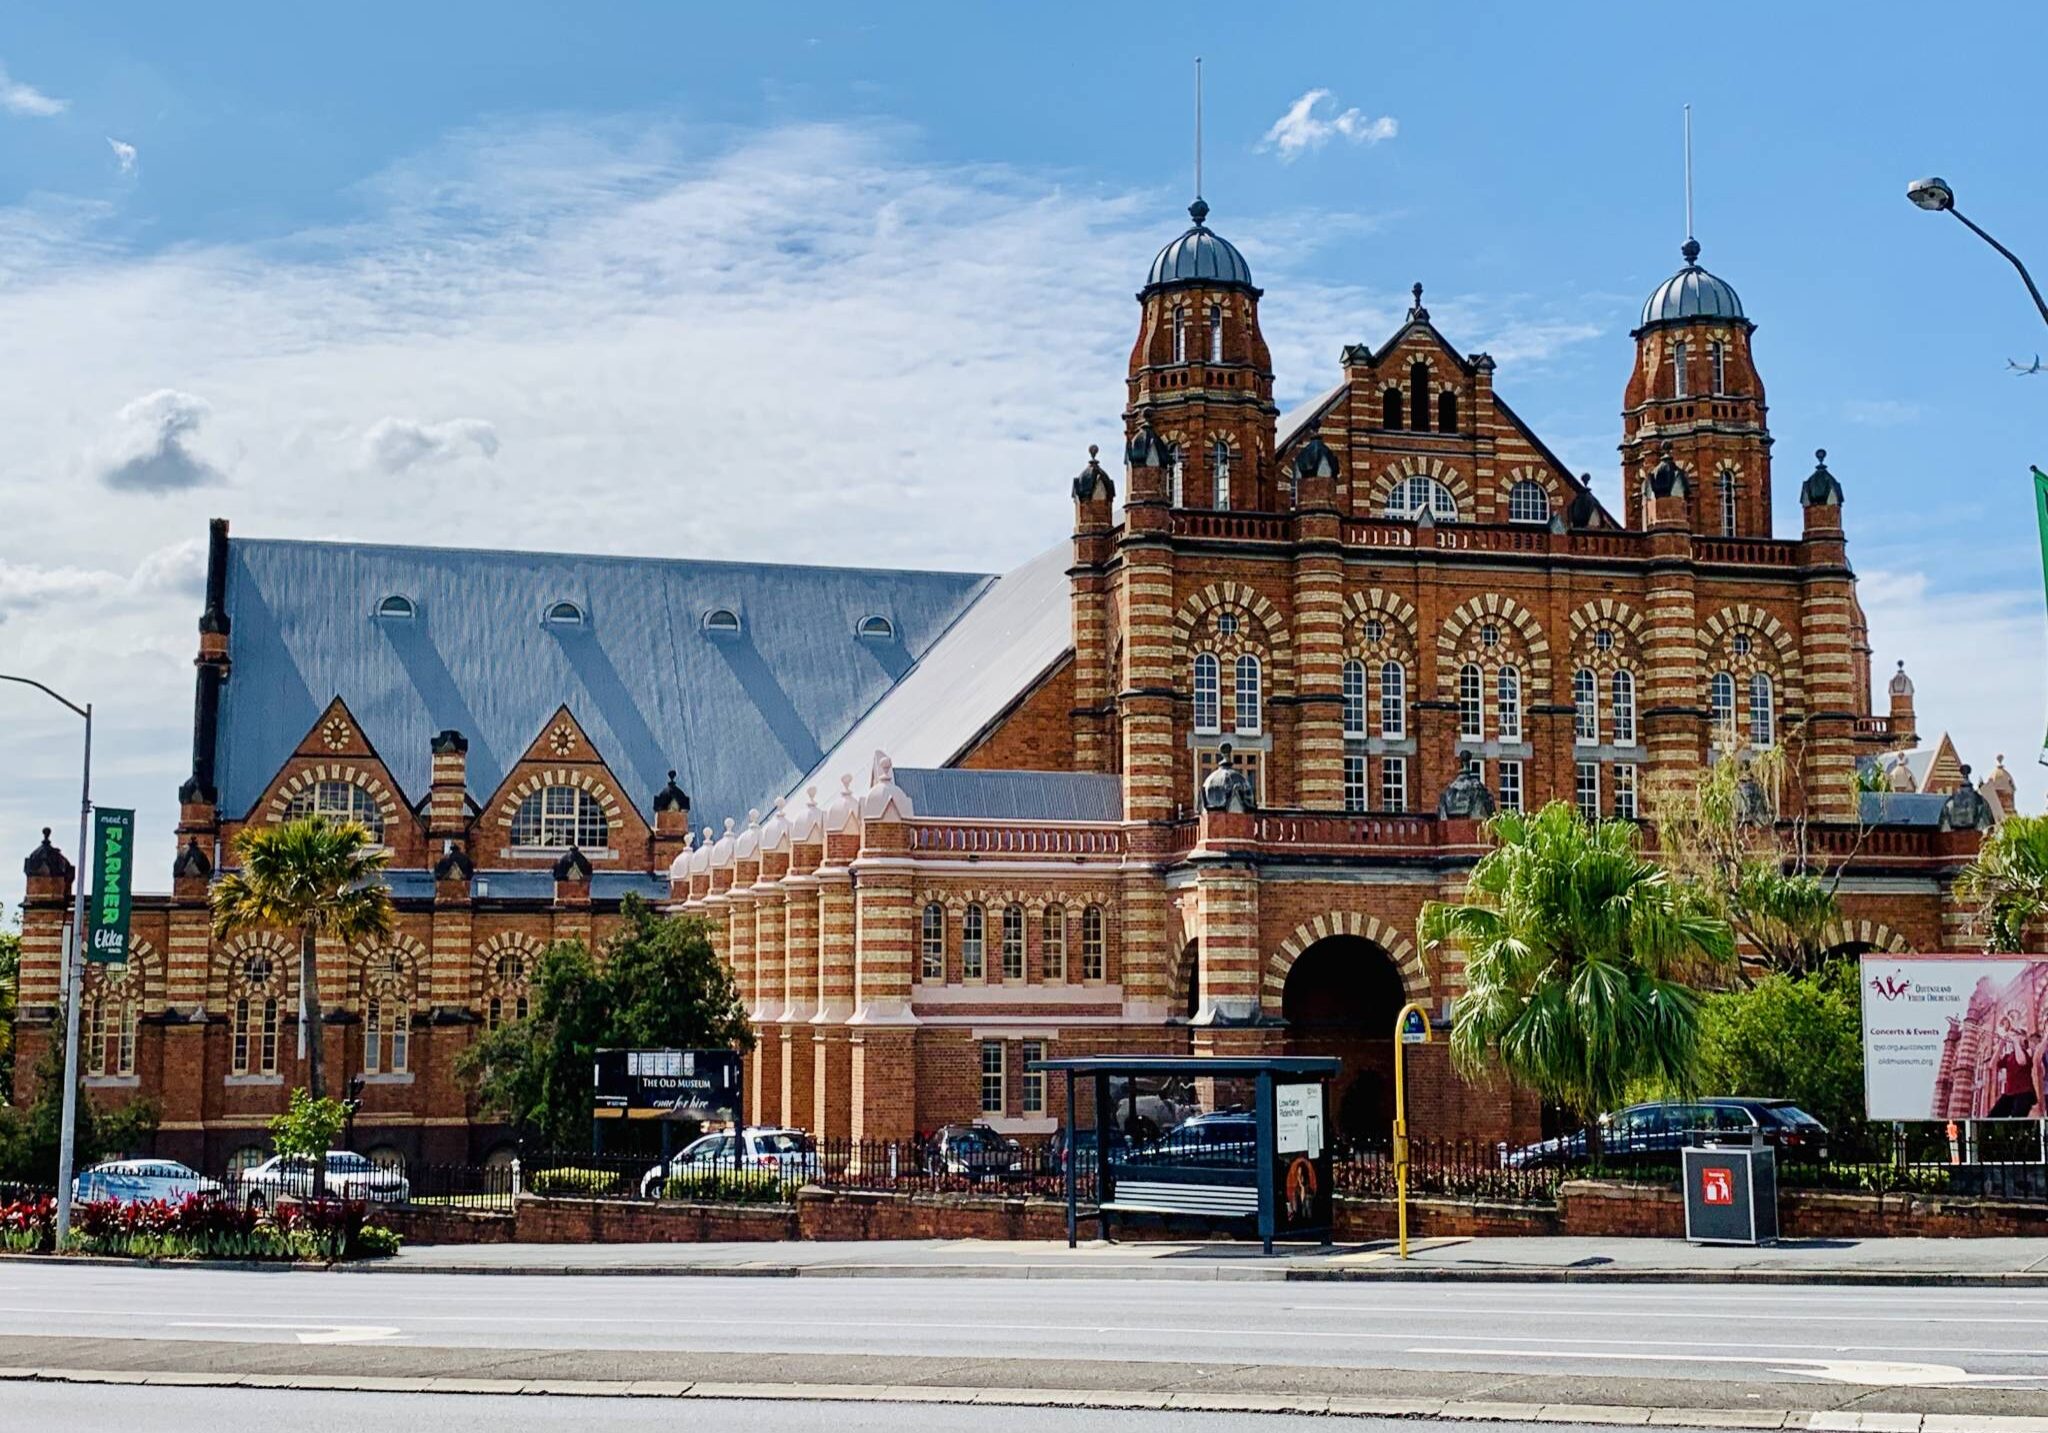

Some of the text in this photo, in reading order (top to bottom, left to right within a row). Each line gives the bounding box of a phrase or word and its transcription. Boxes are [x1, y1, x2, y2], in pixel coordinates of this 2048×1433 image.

[102, 827, 123, 924] FARMER
[94, 928, 123, 949] Ekka
[1870, 1027, 1939, 1036] Concerts & Events
[1878, 1057, 1934, 1067] oldmuseum.org
[659, 1077, 677, 1088] OLD
[677, 1078, 711, 1089] MUSEUM
[671, 1094, 689, 1113] for
[688, 1095, 709, 1109] hire
